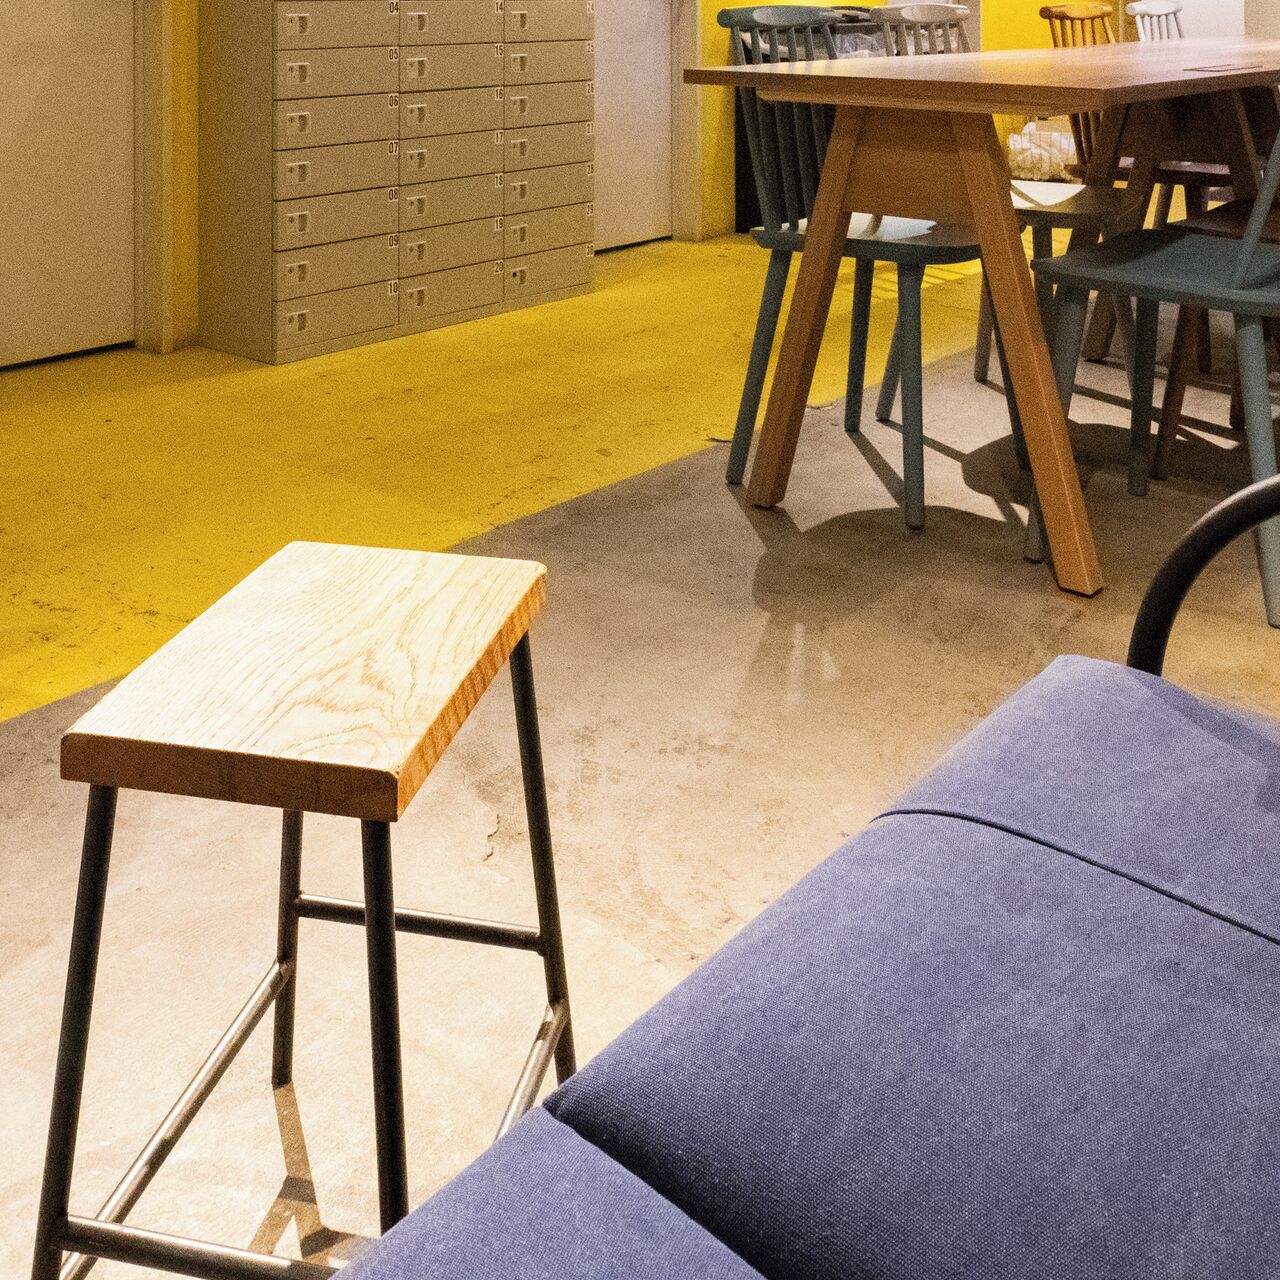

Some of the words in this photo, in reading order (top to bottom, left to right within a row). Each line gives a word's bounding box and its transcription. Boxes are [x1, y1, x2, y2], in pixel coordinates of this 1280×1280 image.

[389, 2, 399, 13] 04
[495, 2, 504, 12] 14
[389, 49, 399, 59] 05
[495, 46, 504, 56] 15
[495, 89, 504, 99] 16
[389, 96, 399, 106] 06
[495, 132, 504, 142] 17
[389, 142, 399, 153] 07
[495, 176, 504, 186] 18
[389, 189, 399, 200] 08
[495, 219, 504, 229] 19
[389, 235, 399, 246] 09
[495, 262, 504, 272] 20
[389, 282, 399, 293] 10
